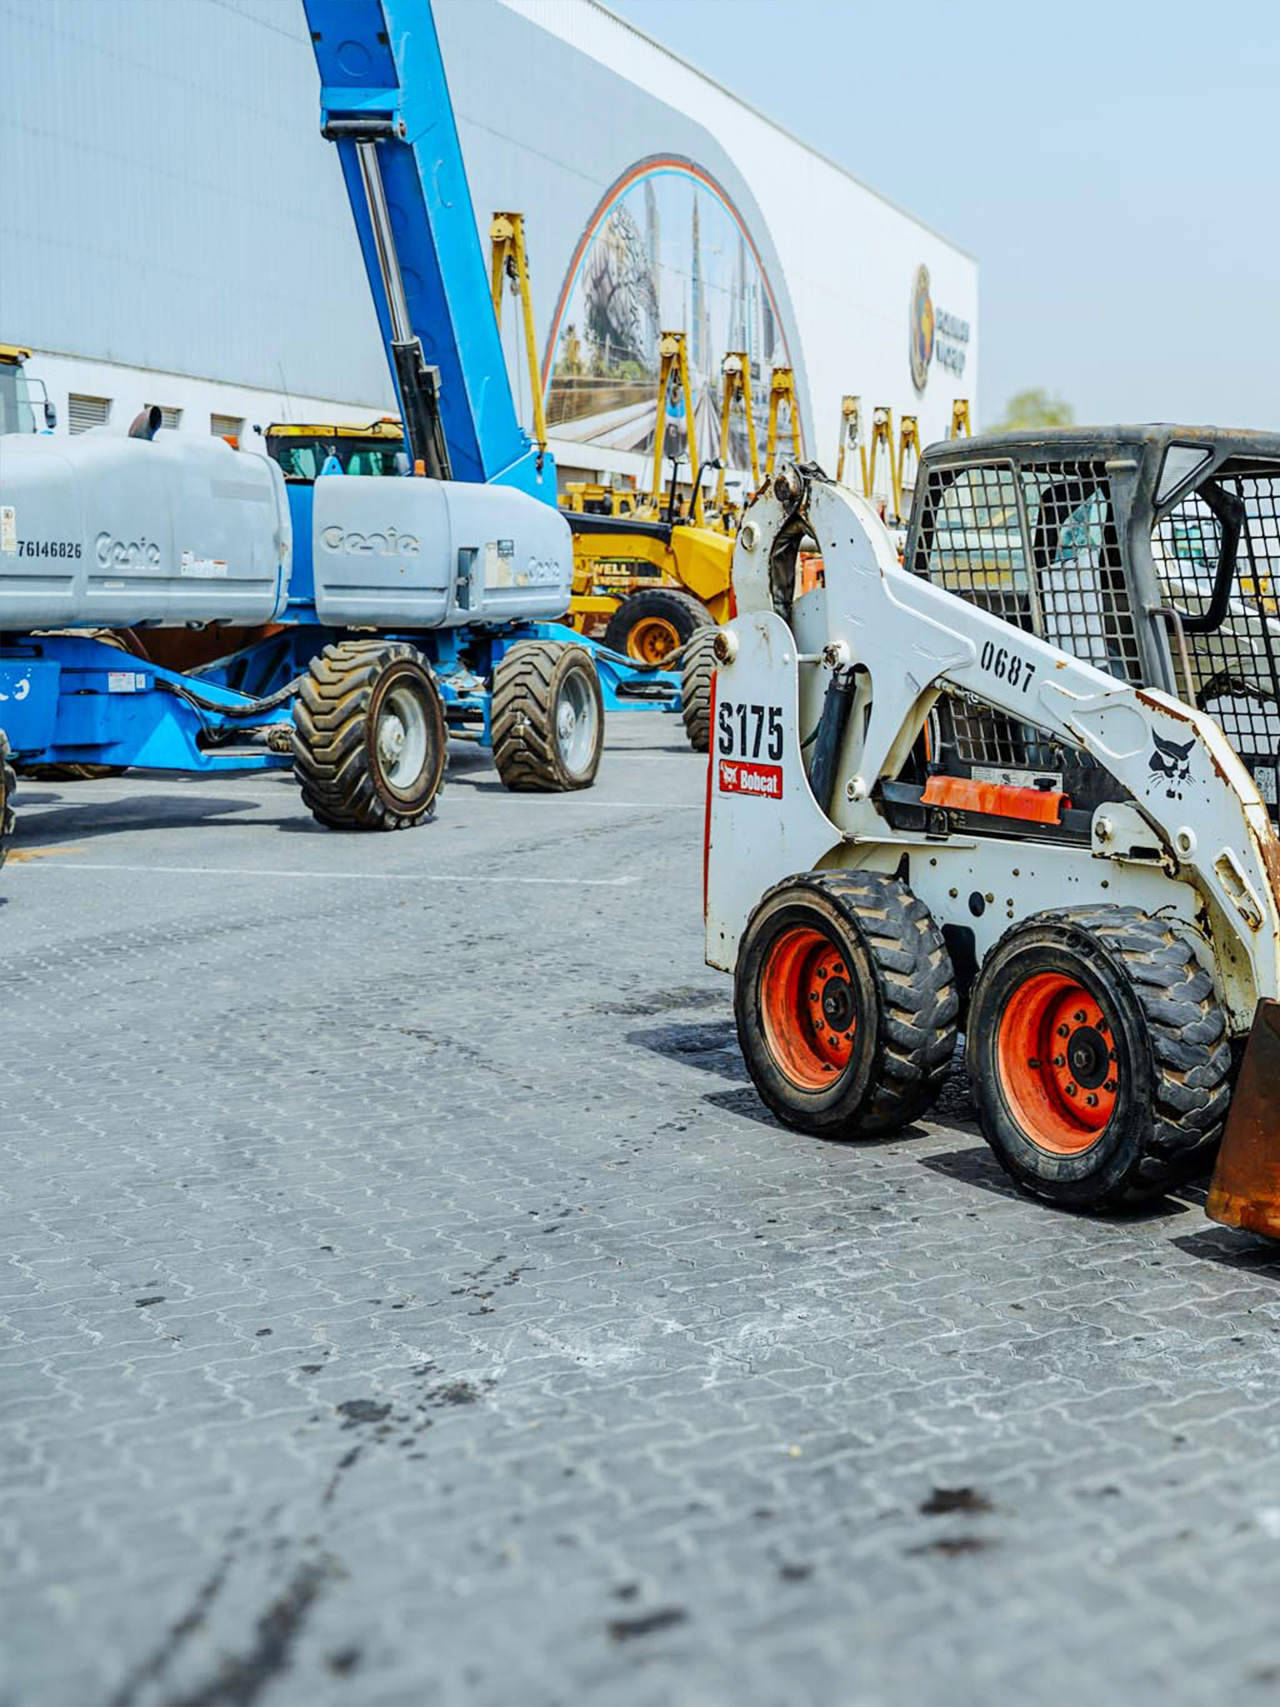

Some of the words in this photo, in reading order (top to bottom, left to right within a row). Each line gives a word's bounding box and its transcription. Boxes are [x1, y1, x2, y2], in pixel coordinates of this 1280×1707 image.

[17, 541, 82, 559] 76146826
[95, 531, 160, 569] Genie
[321, 525, 419, 556] Genie
[981, 641, 1036, 693] 0687
[719, 702, 784, 760] S175
[740, 770, 778, 793] Bobcat
